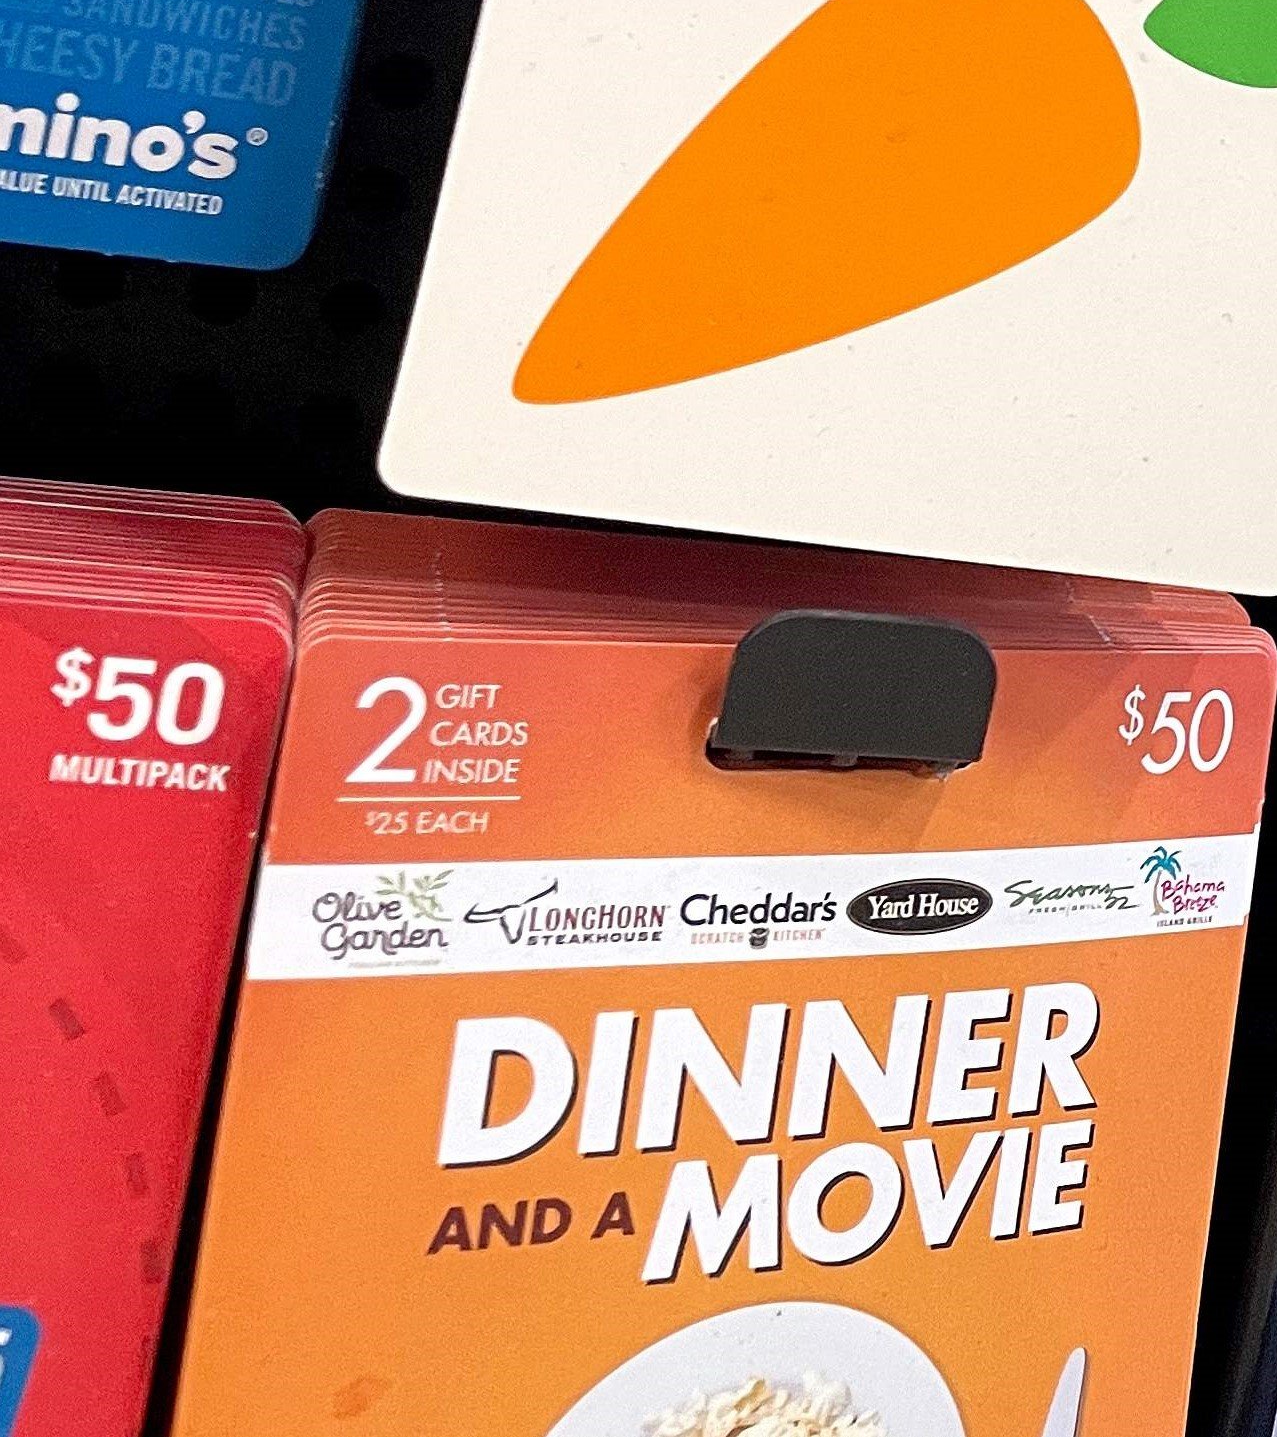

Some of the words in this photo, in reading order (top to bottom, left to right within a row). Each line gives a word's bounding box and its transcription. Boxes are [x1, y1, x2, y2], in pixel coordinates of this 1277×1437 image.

[147, 43, 299, 110] BREAD
[52, 174, 112, 204] UNTIL
[115, 183, 225, 216] ACTIVATED
[49, 646, 226, 746] $50
[435, 682, 503, 711] GIFT
[345, 675, 429, 783] 2
[430, 720, 530, 748] CARDS
[1117, 683, 1235, 776] $50
[49, 755, 231, 792] MULTIPACK
[422, 759, 521, 784] INSIDE
[365, 810, 409, 835] $25
[415, 811, 490, 835] EACH
[1160, 873, 1226, 902] Bahama
[1171, 893, 1220, 915] Breeze
[311, 890, 403, 924] Olive
[679, 891, 838, 927] Cheddar's
[868, 893, 914, 921] Yard
[914, 891, 980, 918] House
[320, 919, 450, 961] Garden
[525, 930, 664, 947] STEAKHOUSE
[438, 981, 1100, 1169] DINNER
[426, 1197, 573, 1255] AND
[590, 1190, 636, 1240] A
[641, 1118, 1096, 1285] MOVIE
